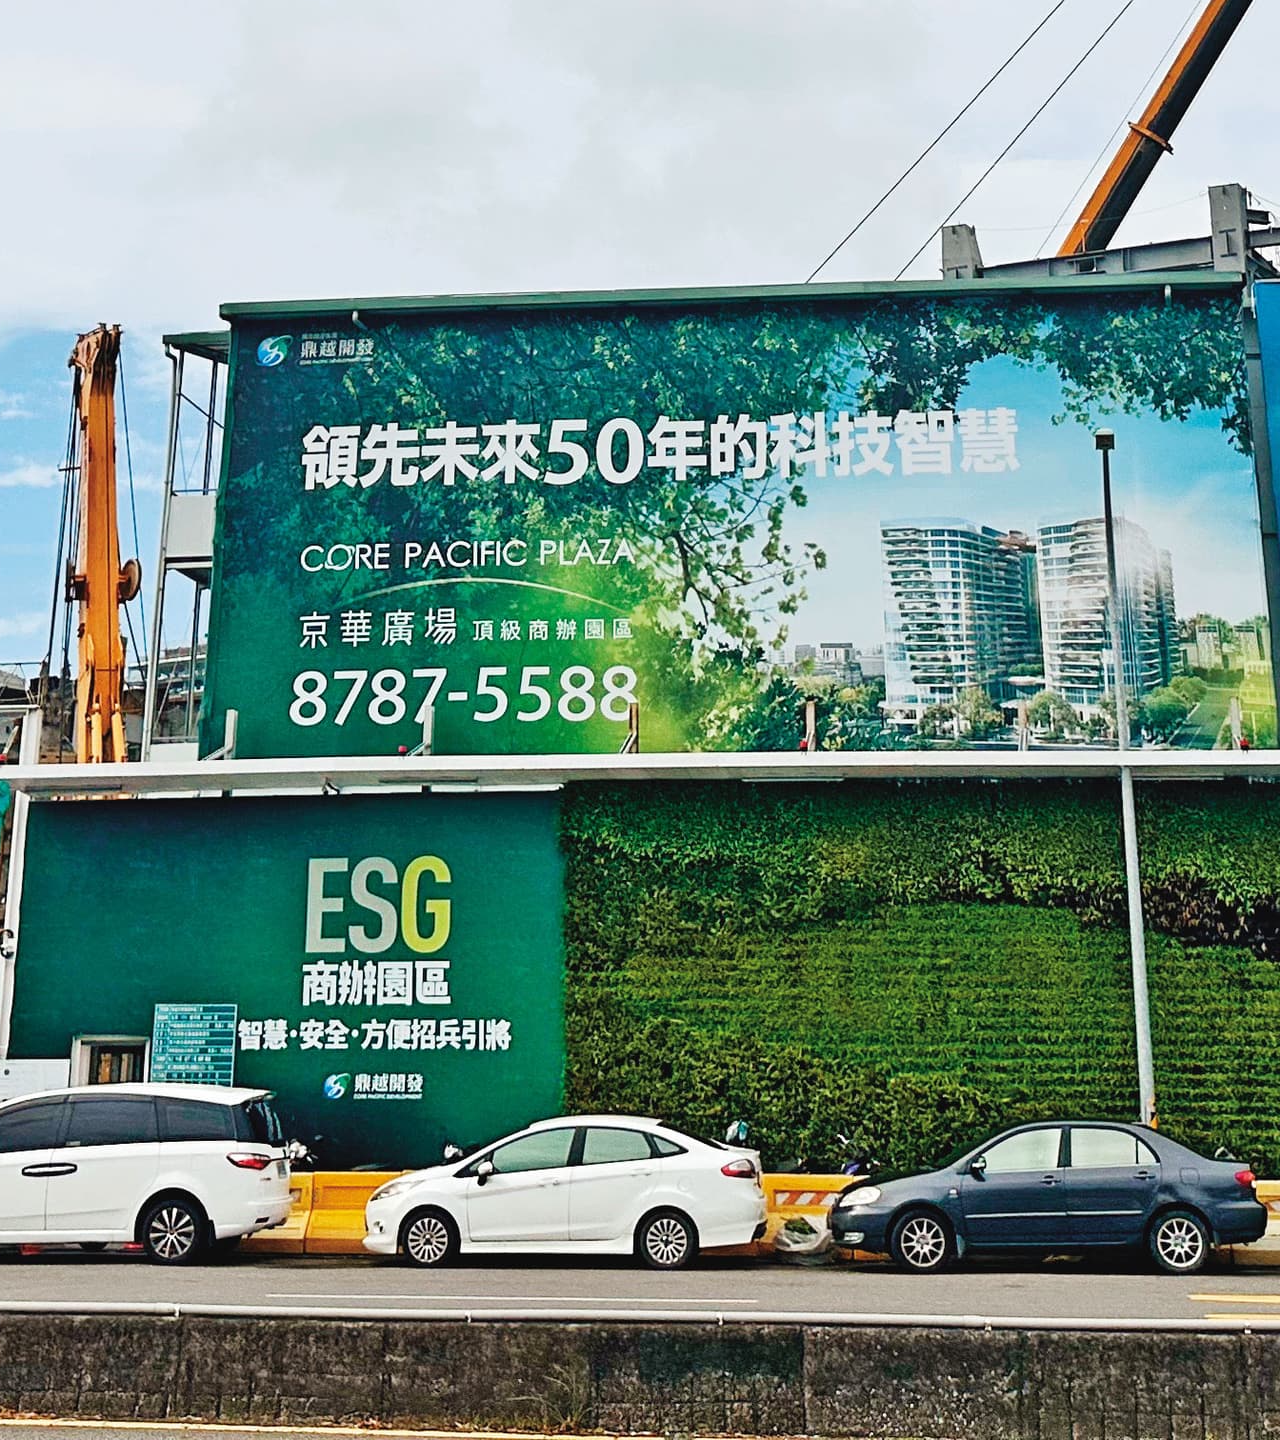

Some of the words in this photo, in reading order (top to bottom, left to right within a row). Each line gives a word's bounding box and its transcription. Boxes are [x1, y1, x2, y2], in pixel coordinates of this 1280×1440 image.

[300, 338, 375, 359] 鼎越開發
[301, 408, 1021, 491] 領先未來50年的科技智慧
[300, 543, 390, 572] CORE
[404, 540, 528, 569] PACIFIC
[539, 538, 636, 566] PLAZA
[299, 607, 458, 649] 京華廣場
[472, 618, 634, 642] 頂級商辦園區
[289, 665, 638, 726] 8787-5588
[305, 855, 452, 954] ESG
[302, 960, 451, 1006] 商辦園區
[354, 1072, 424, 1093] 鼎越開發
